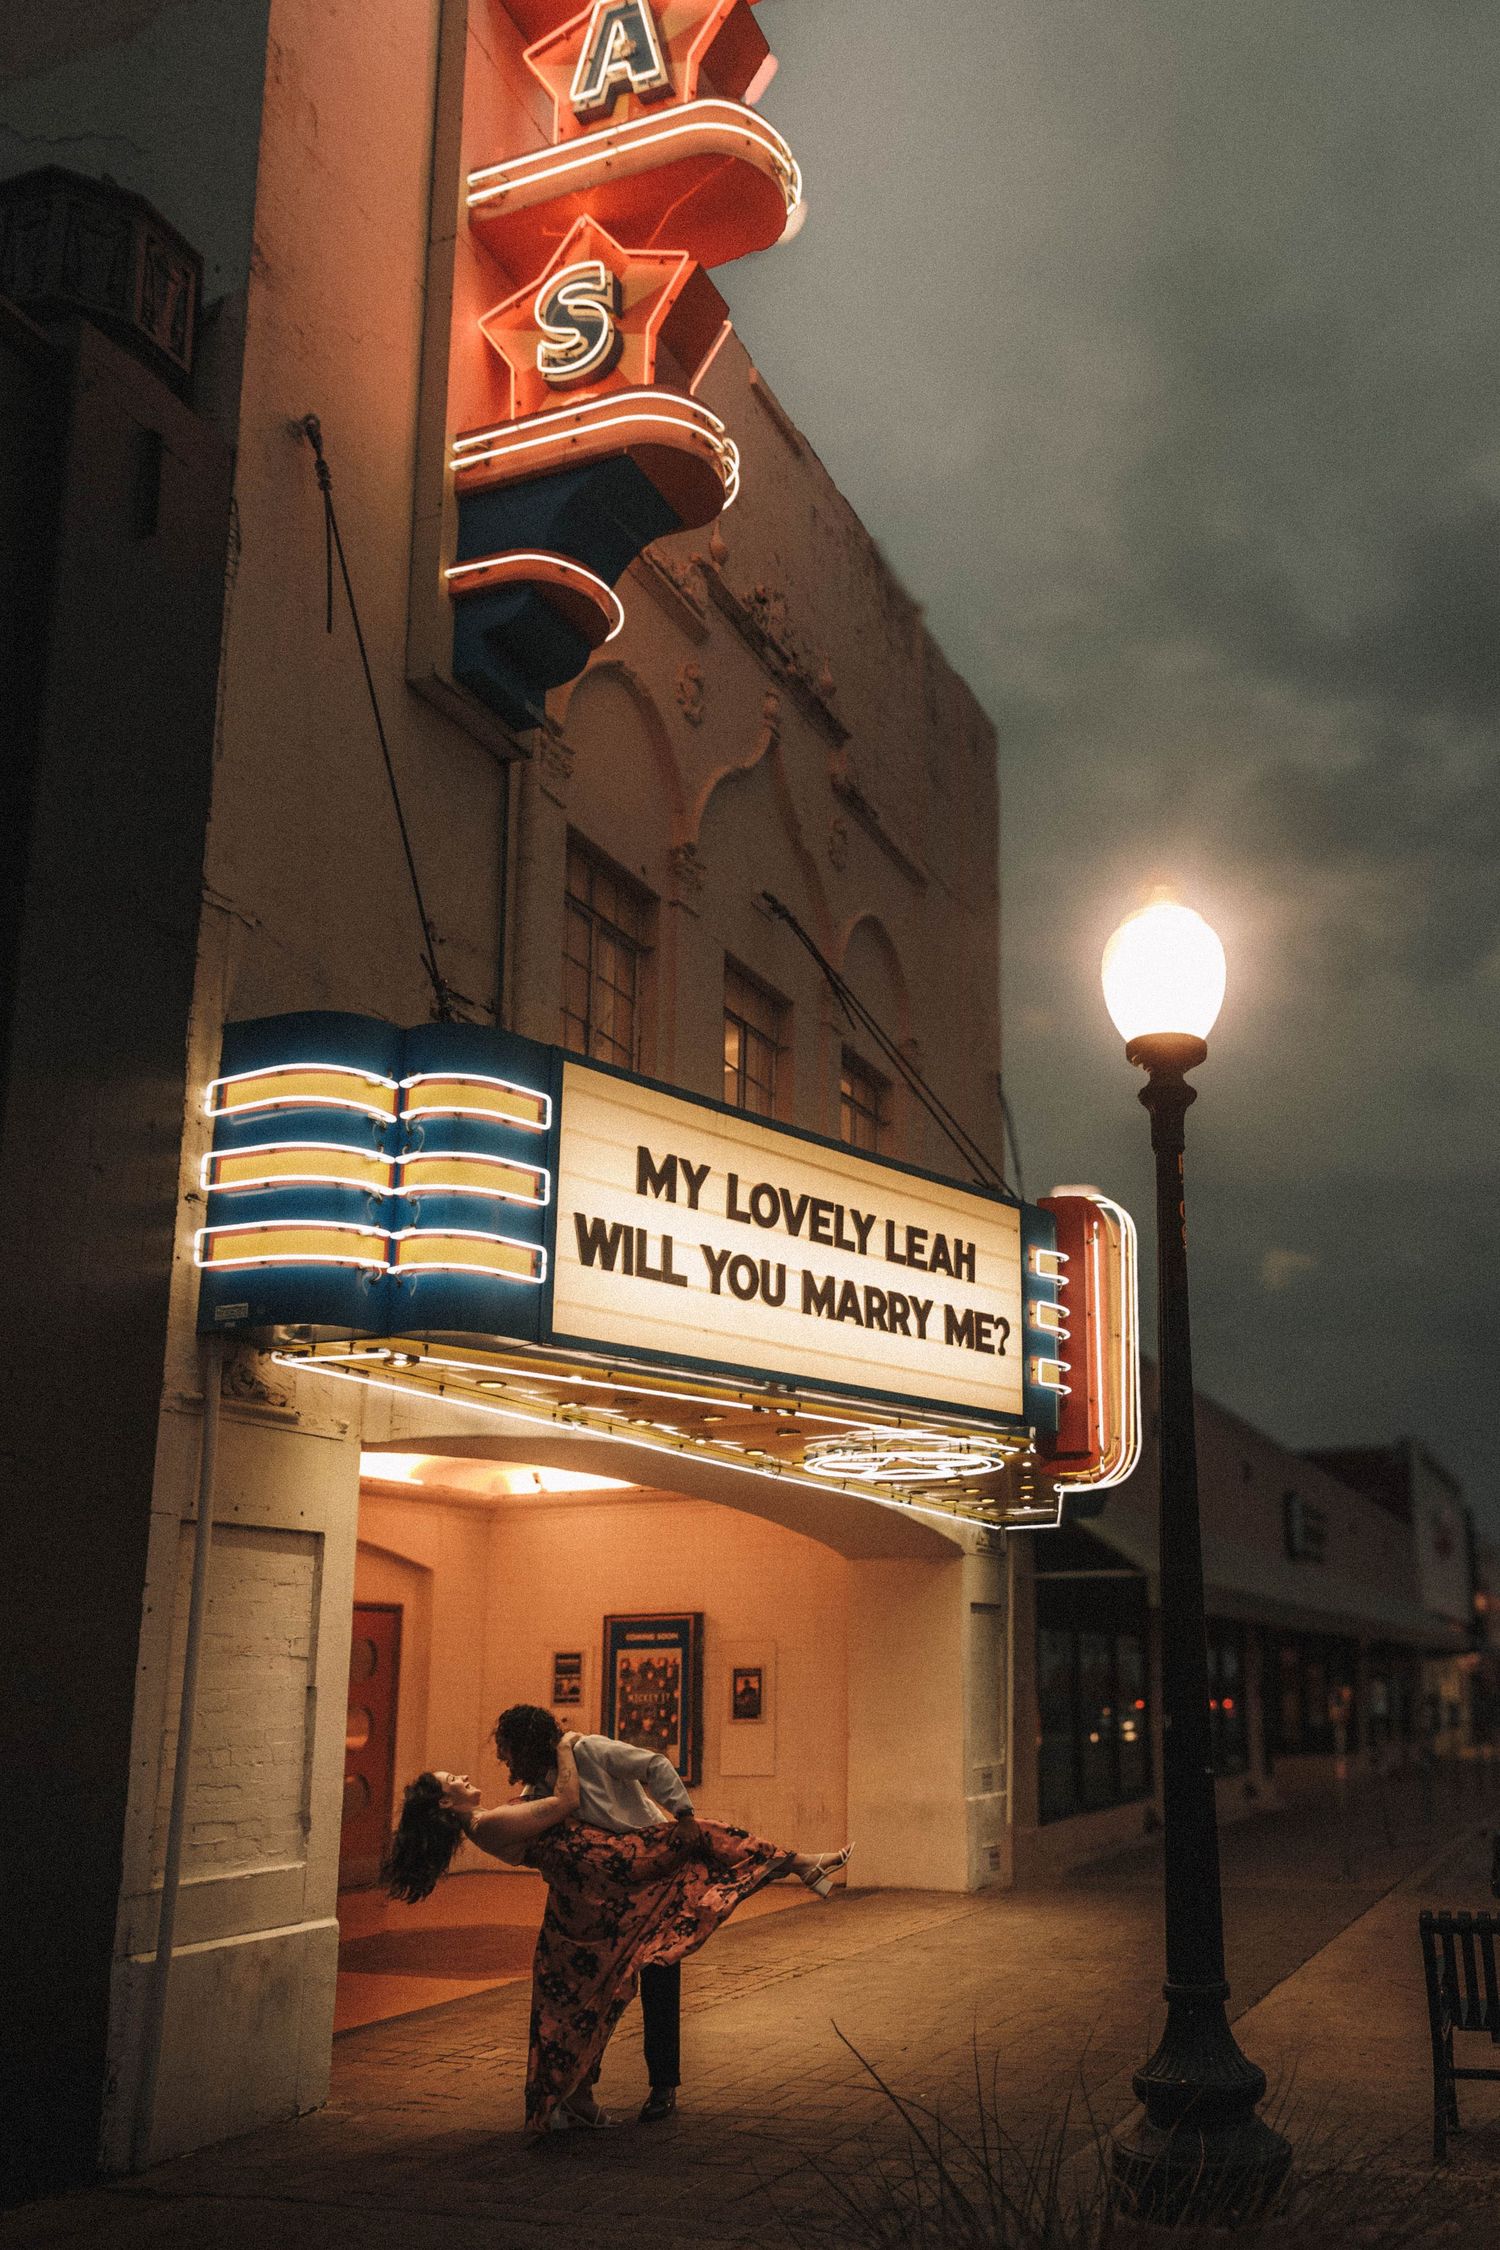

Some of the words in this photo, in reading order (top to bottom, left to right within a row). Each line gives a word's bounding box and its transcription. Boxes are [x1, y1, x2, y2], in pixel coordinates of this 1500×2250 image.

[574, 1212, 688, 1288] WILL
[700, 1244, 786, 1307] YOU
[802, 1269, 934, 1340] MARRY
[944, 1304, 1010, 1356] ME?
[636, 1145, 711, 1210] MY
[726, 1173, 877, 1256] LOVELY
[885, 1219, 976, 1283] LEAH
